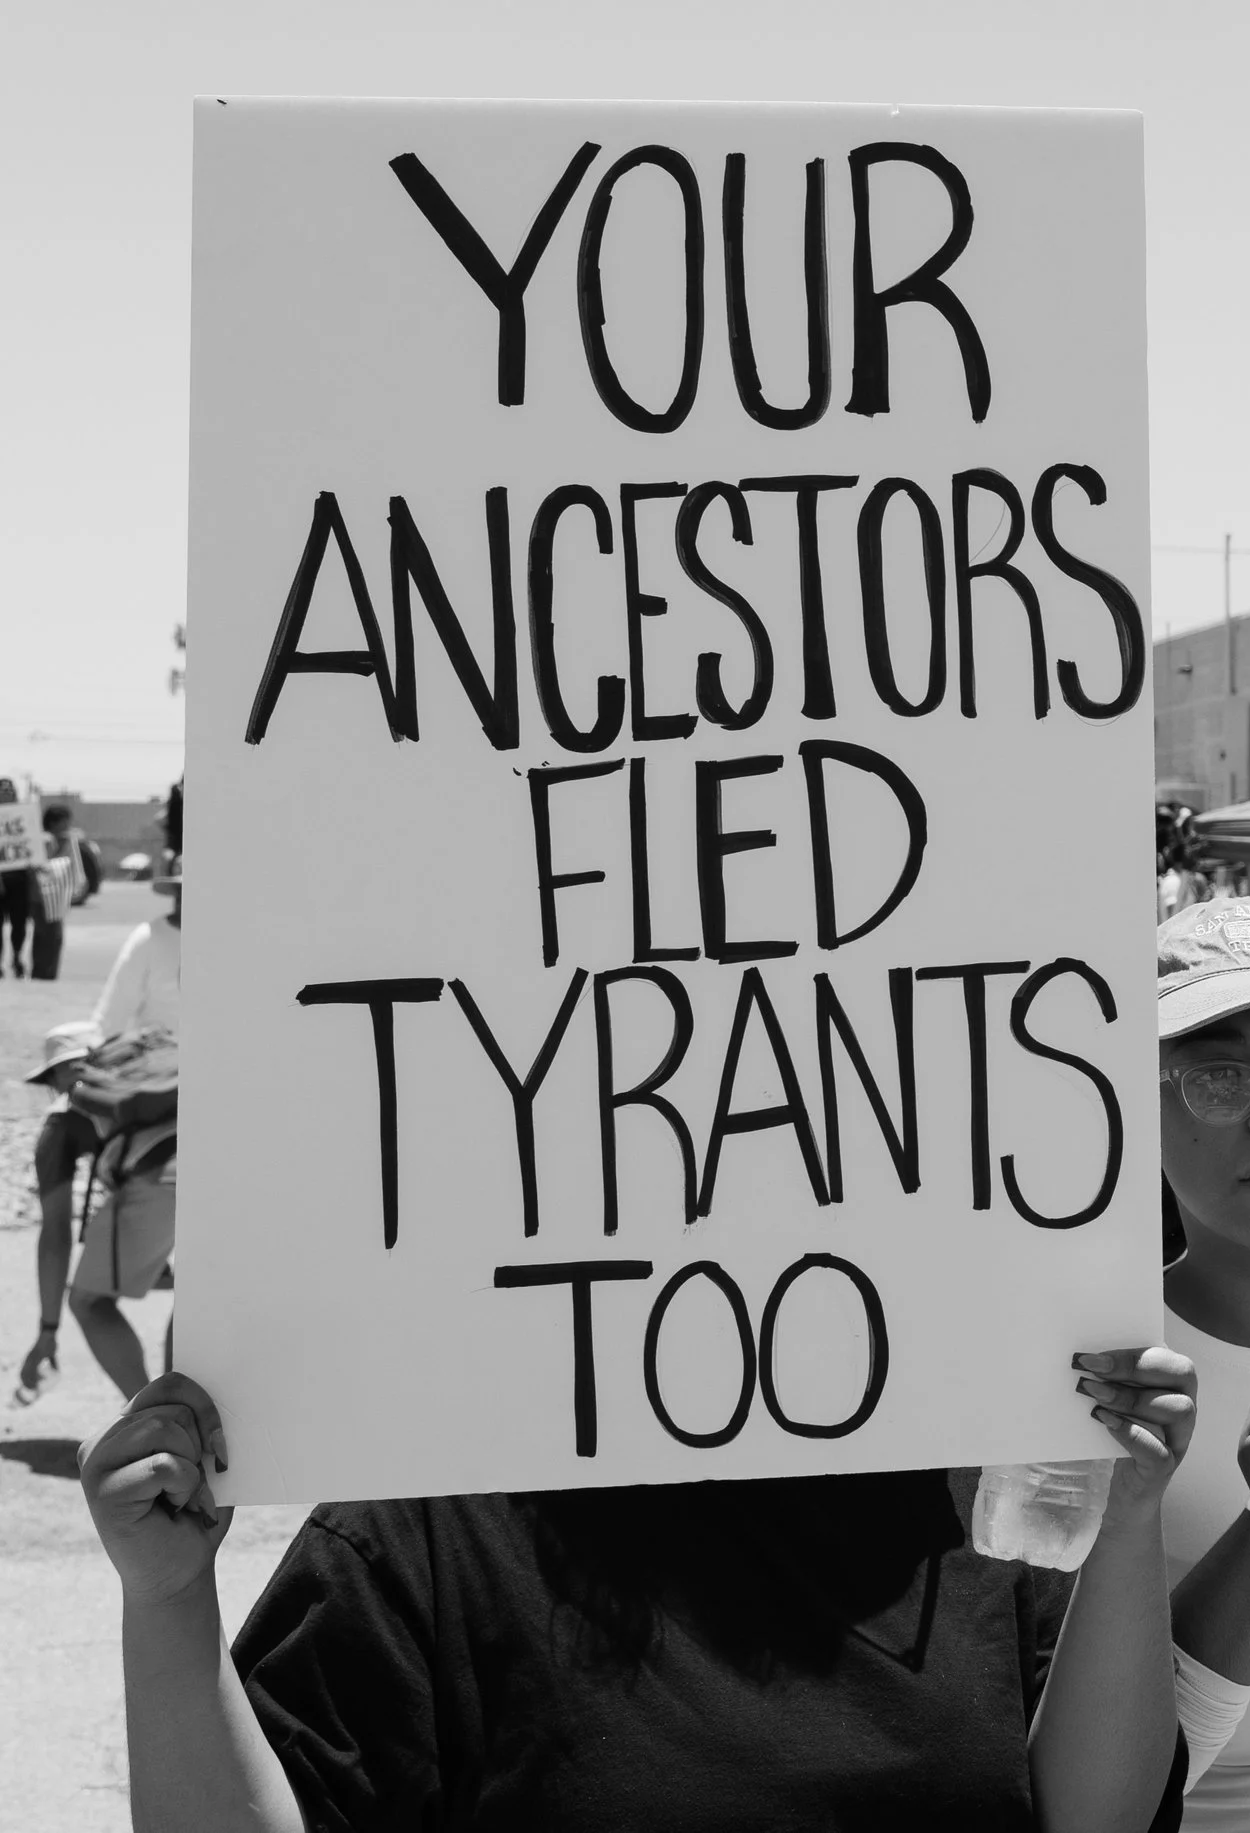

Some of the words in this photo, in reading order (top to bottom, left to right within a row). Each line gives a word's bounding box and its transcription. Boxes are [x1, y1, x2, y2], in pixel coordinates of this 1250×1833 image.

[389, 140, 991, 434] YOUR
[245, 463, 1146, 754] ANCESTORS
[525, 740, 927, 968] FLED
[1194, 911, 1230, 937] SAN
[296, 958, 1124, 1249] TYRANTS
[494, 1253, 890, 1457] TOO
